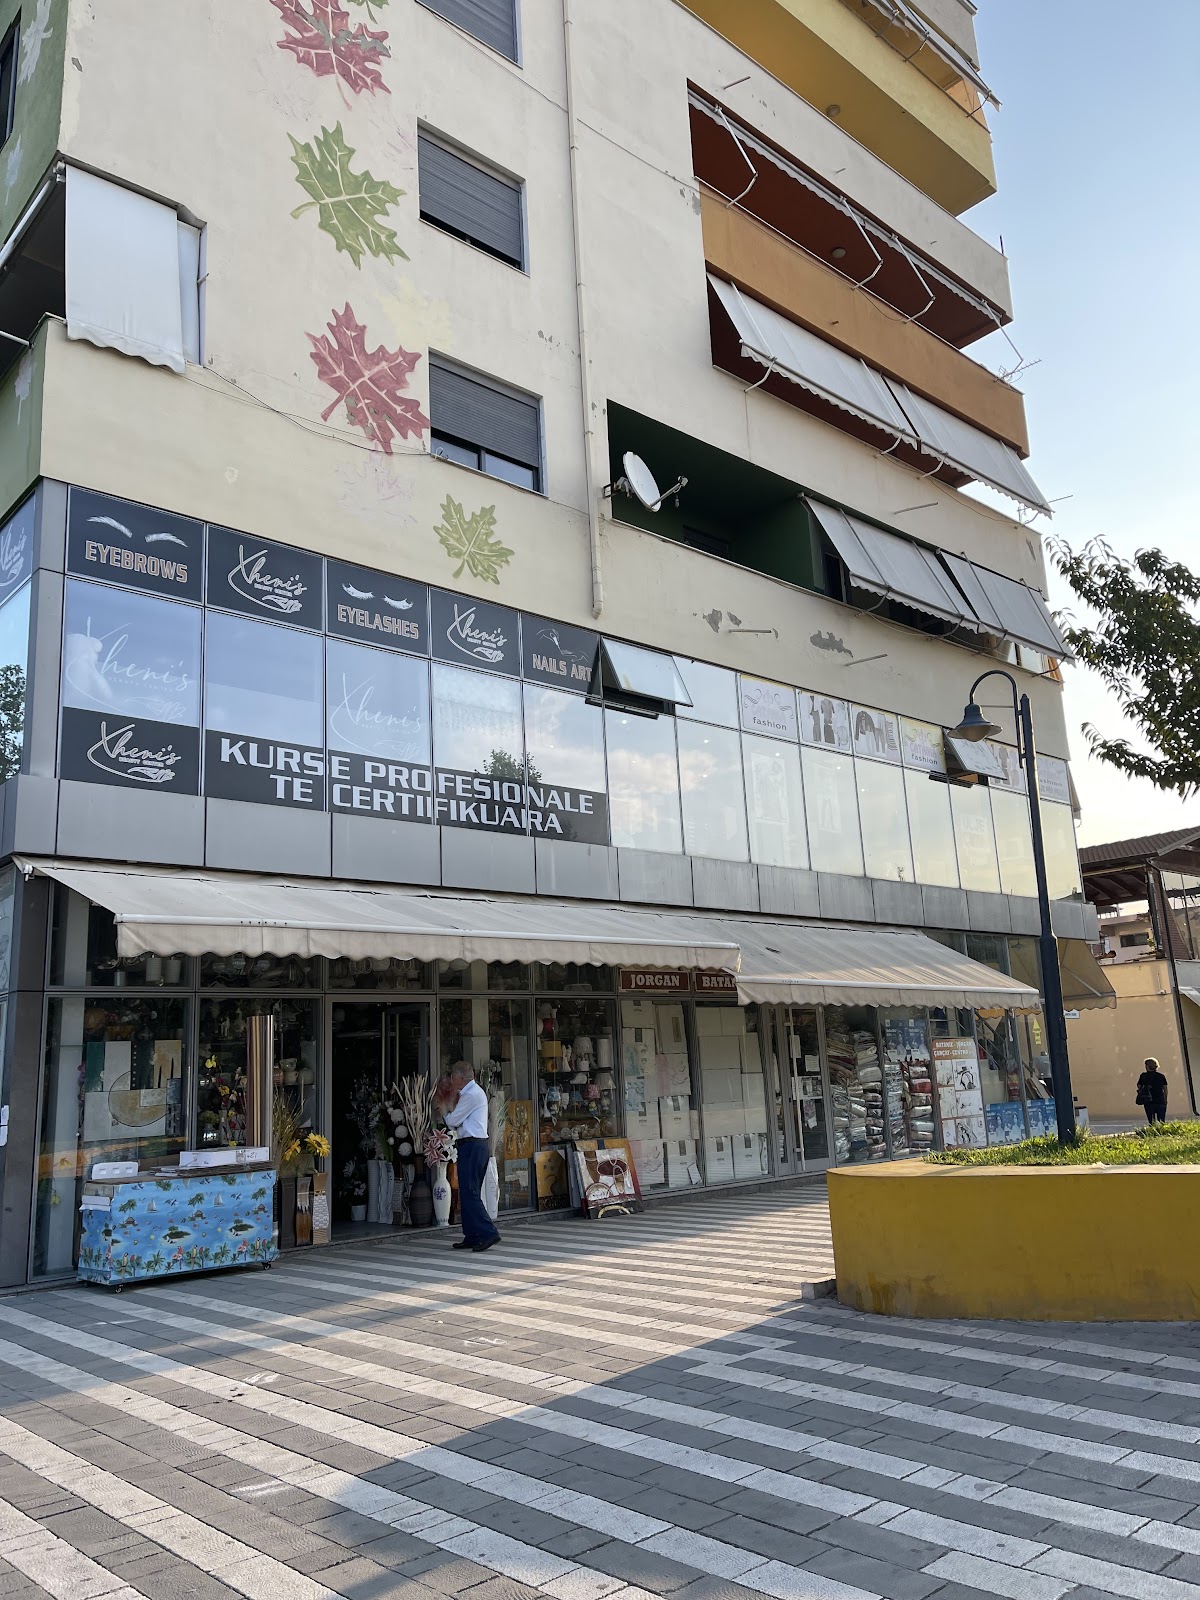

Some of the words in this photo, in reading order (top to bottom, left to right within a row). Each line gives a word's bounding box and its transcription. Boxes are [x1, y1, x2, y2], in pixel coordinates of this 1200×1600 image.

[85, 540, 188, 583] EYEBROWS
[337, 604, 419, 640] EYELASHES
[532, 654, 567, 676] NAILS
[570, 666, 593, 682] ART
[753, 716, 787, 731] fashion
[87, 721, 182, 765] Xheni's
[912, 753, 938, 765] fashion
[220, 738, 351, 780] KURSE
[364, 760, 594, 815] PROFESIONALE
[270, 774, 313, 802] TE
[1040, 779, 1063, 788] ashion
[631, 974, 680, 989] JORGAN
